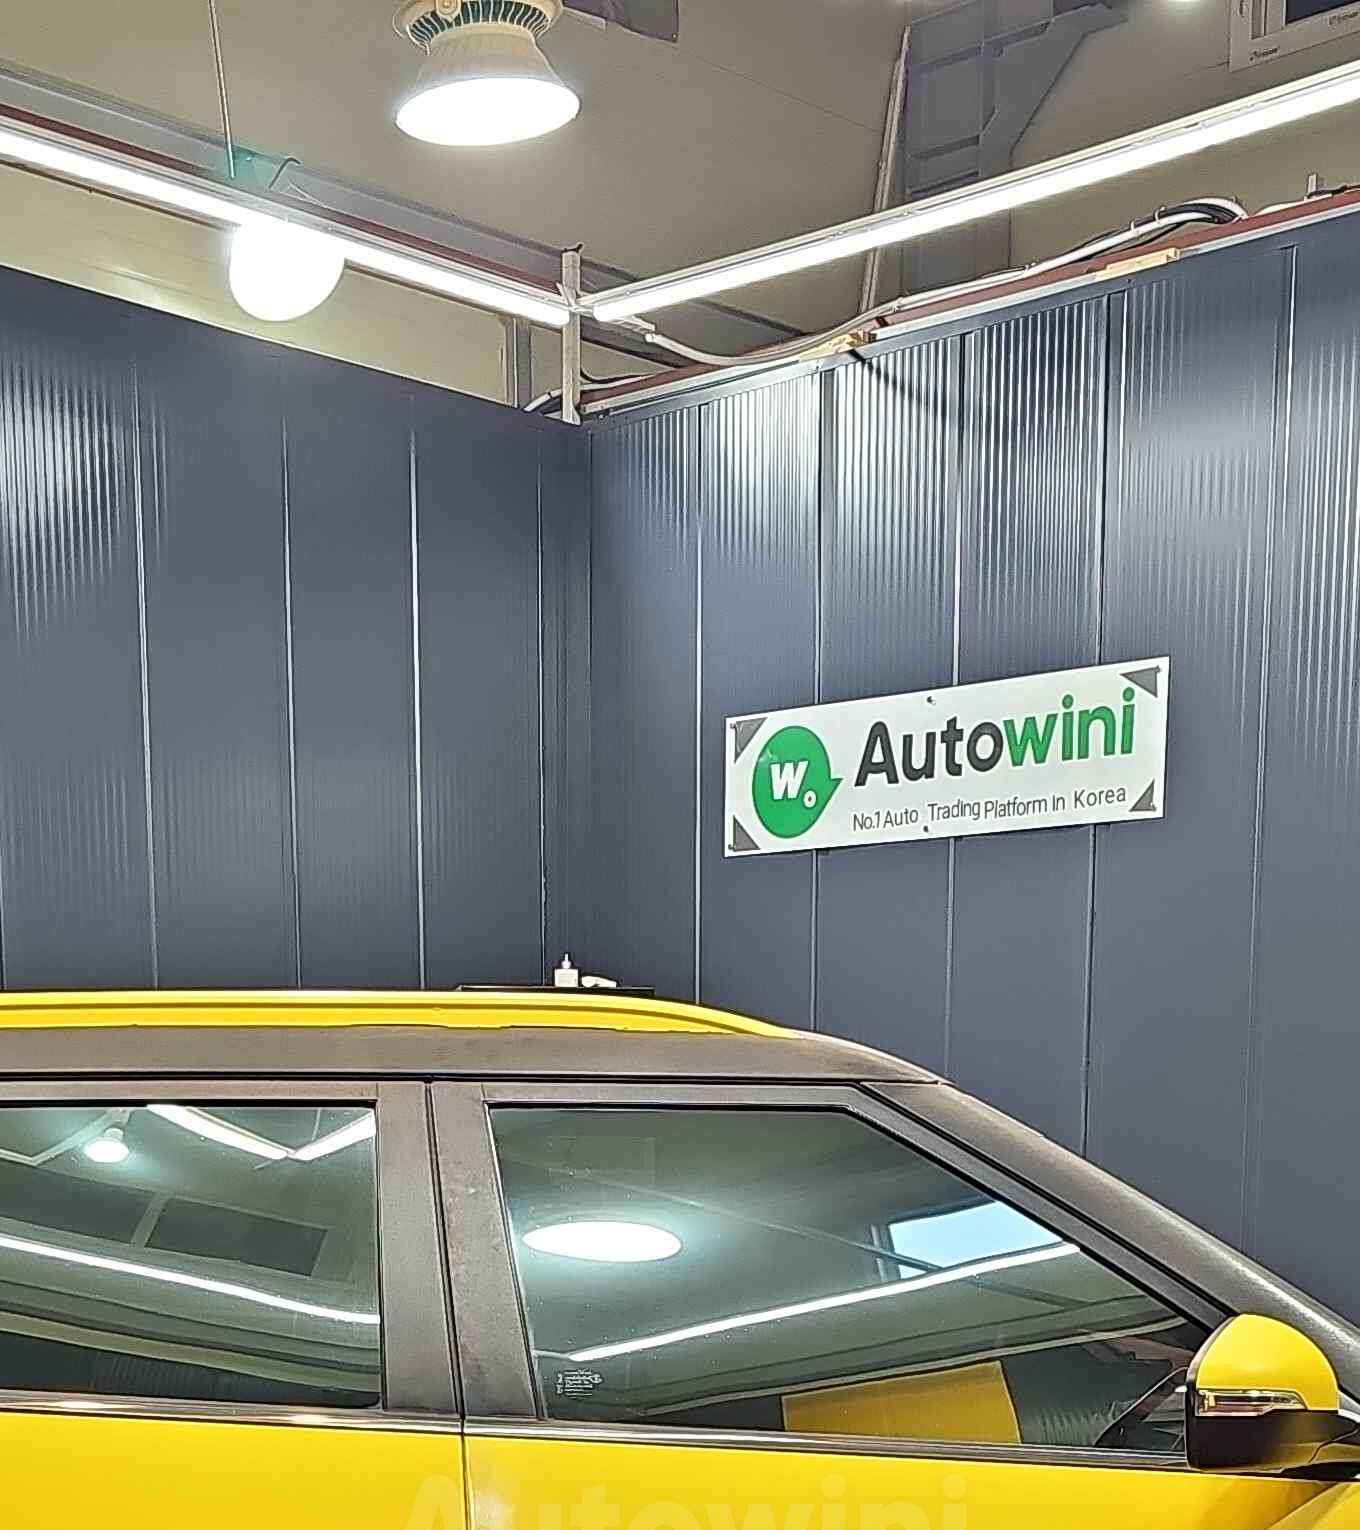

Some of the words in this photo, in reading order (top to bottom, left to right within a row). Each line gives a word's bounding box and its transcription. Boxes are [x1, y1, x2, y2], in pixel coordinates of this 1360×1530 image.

[853, 687, 1136, 787] Autowini
[883, 810, 919, 828] Auto
[928, 801, 981, 822] Trading
[984, 796, 1048, 819] Platform
[1074, 788, 1127, 809] Korea
